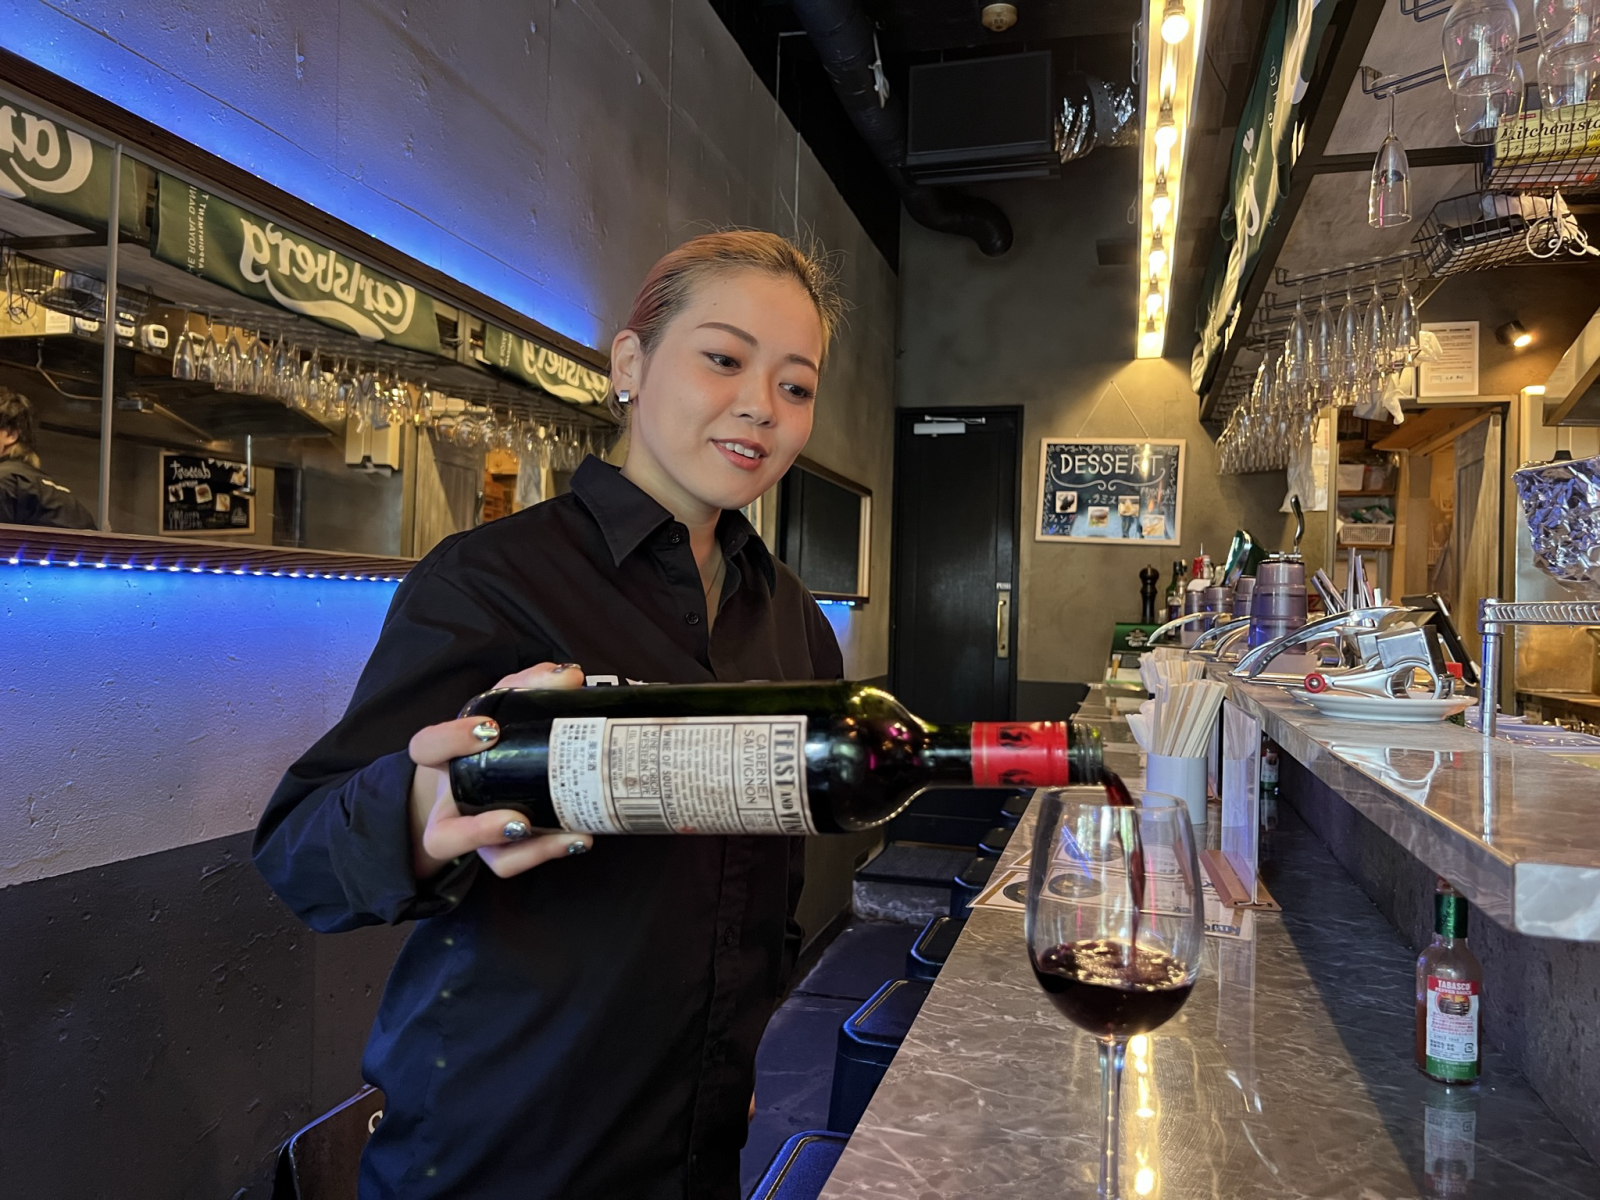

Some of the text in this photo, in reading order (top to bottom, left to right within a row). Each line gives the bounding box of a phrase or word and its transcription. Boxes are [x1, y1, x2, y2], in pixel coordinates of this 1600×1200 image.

[1060, 452, 1164, 477] DESSERT
[587, 740, 598, 771] 果実酒
[640, 729, 651, 795] WESTERN CAPE
[649, 730, 660, 795] WINE OF ORIGIN
[661, 729, 681, 826] WINE OF SOUTH AFRICA
[743, 729, 758, 804] SAUVIGNON
[755, 733, 770, 801] CABERNET
[773, 728, 797, 790] FEAST
[780, 791, 795, 810] AND
[1437, 979, 1471, 991] TABASCO
